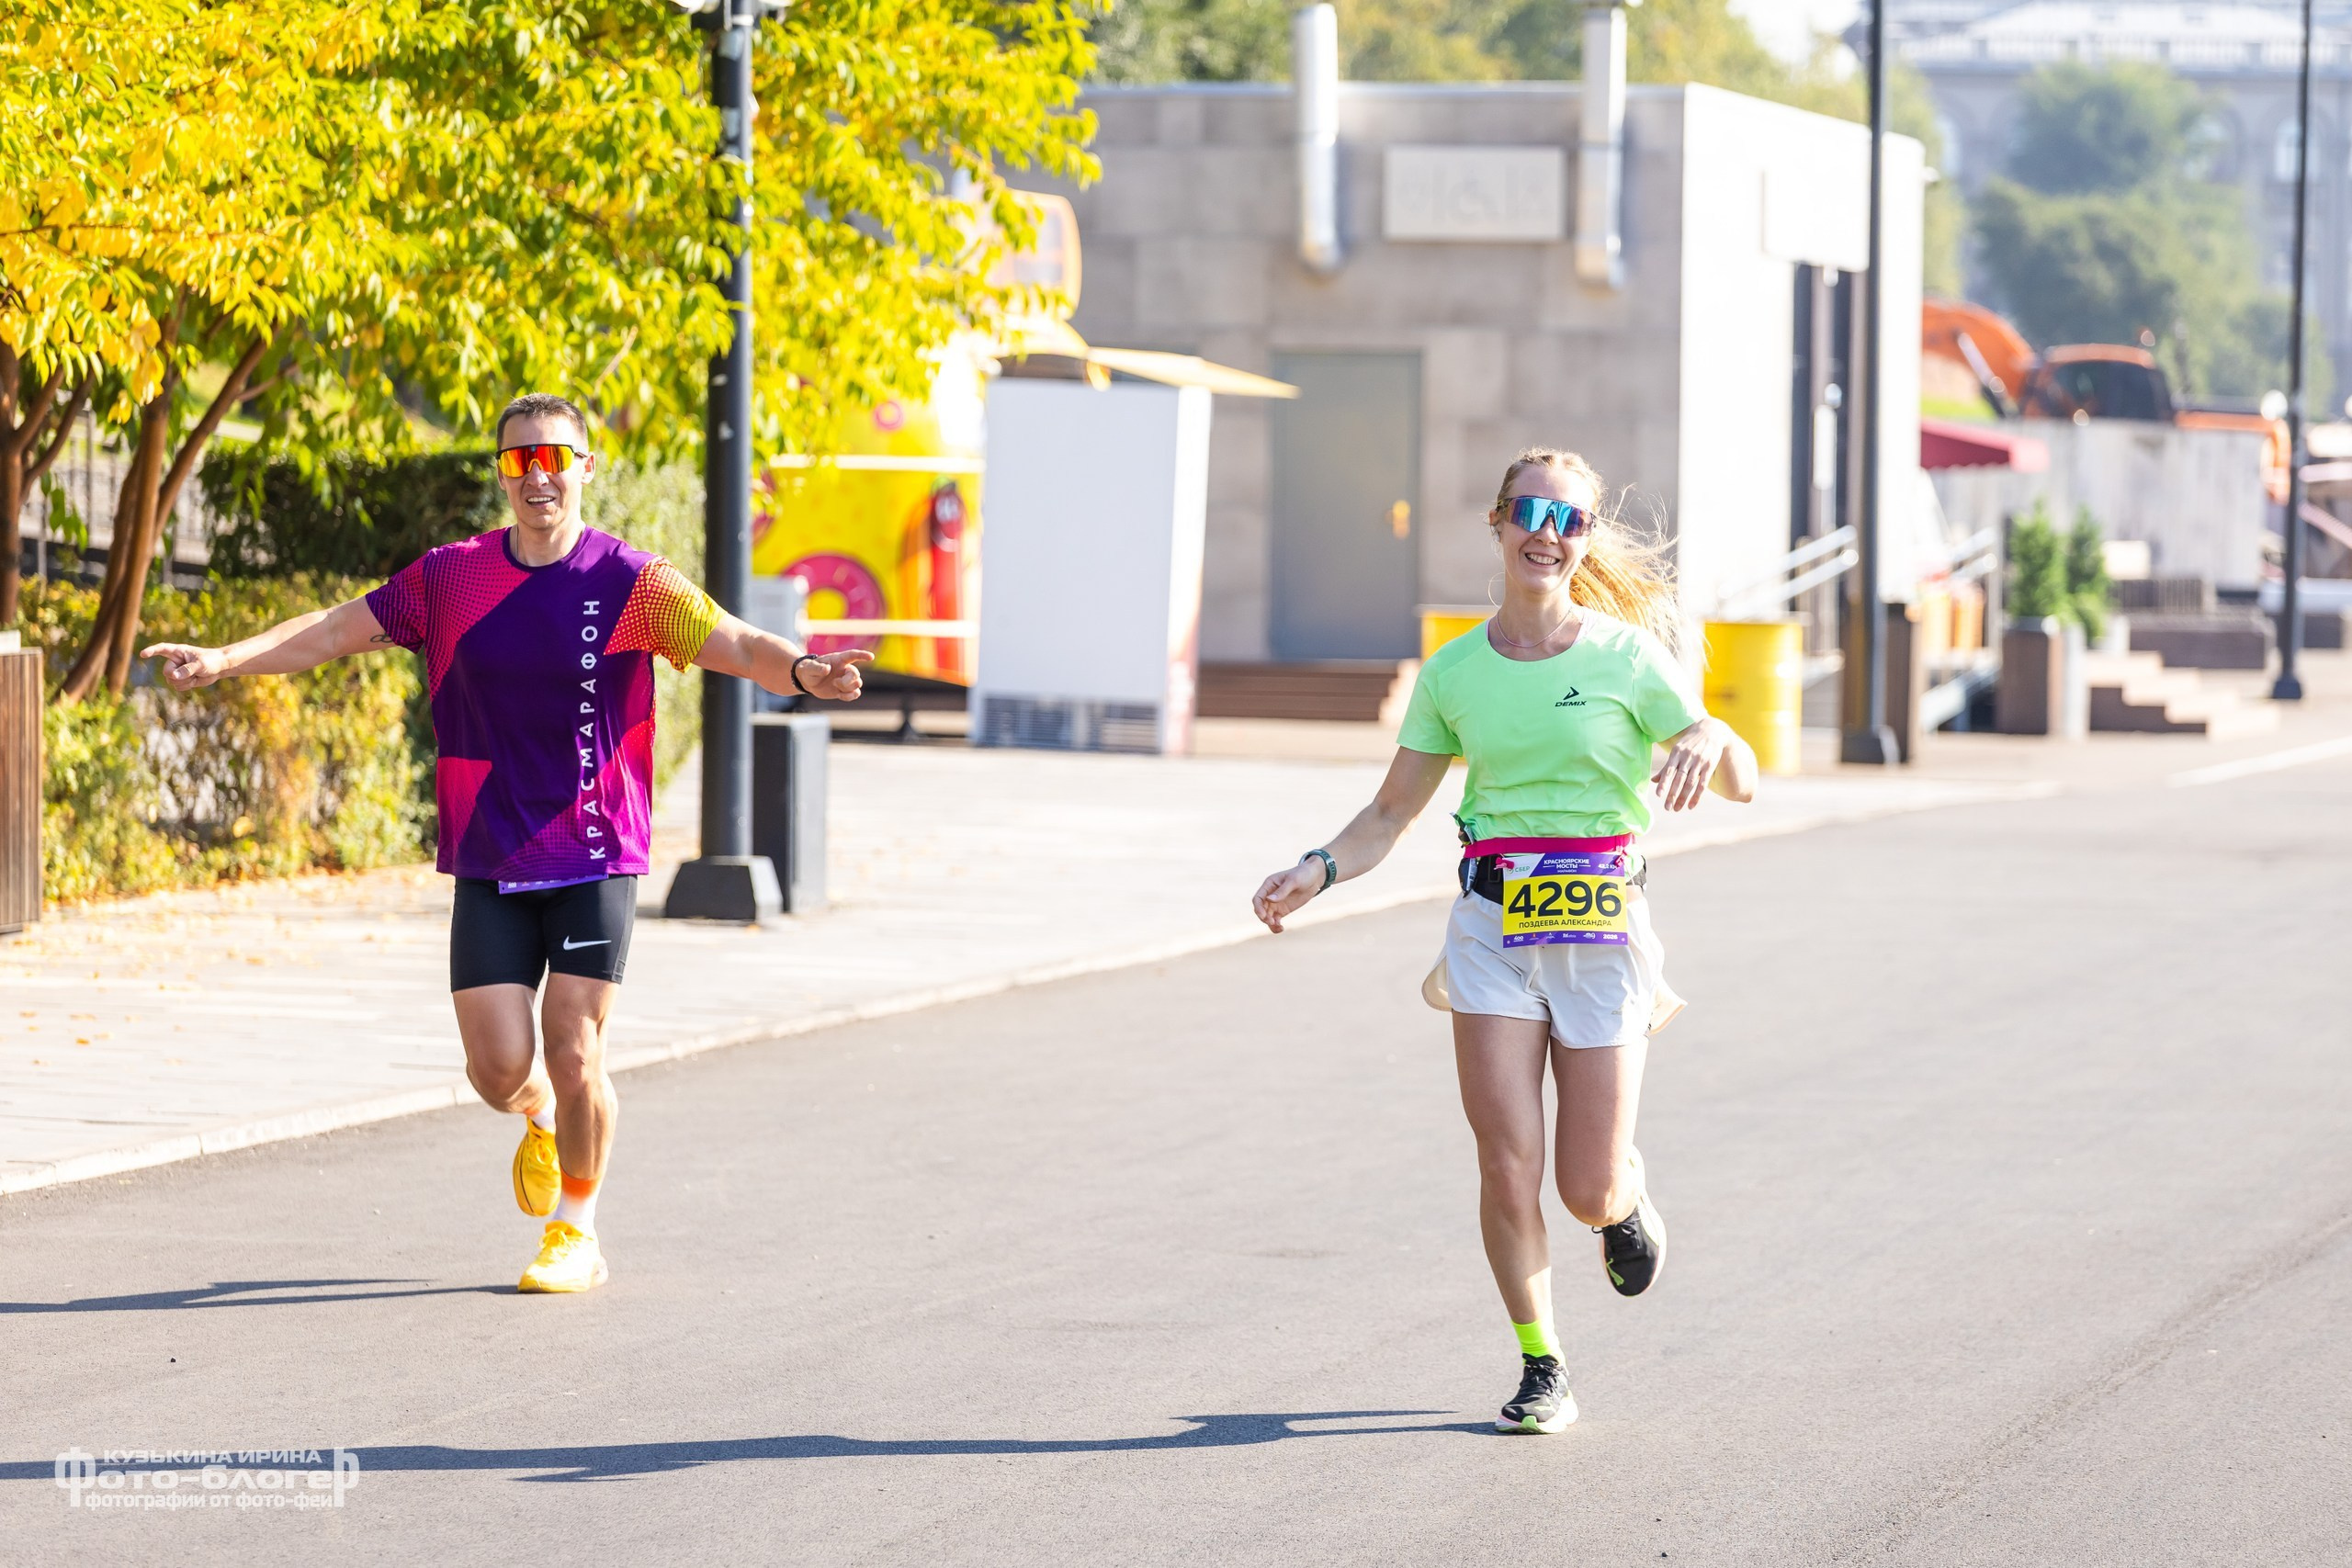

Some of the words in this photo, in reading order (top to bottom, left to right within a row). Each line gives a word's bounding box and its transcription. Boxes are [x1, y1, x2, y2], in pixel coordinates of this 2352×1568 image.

[580, 601, 605, 860] КРАСМАРАФОН
[1508, 880, 1622, 919] 4296
[1519, 919, 1559, 929] ПОЗДЕЕВА
[1561, 919, 1612, 927] АЛЕКСАНДРА
